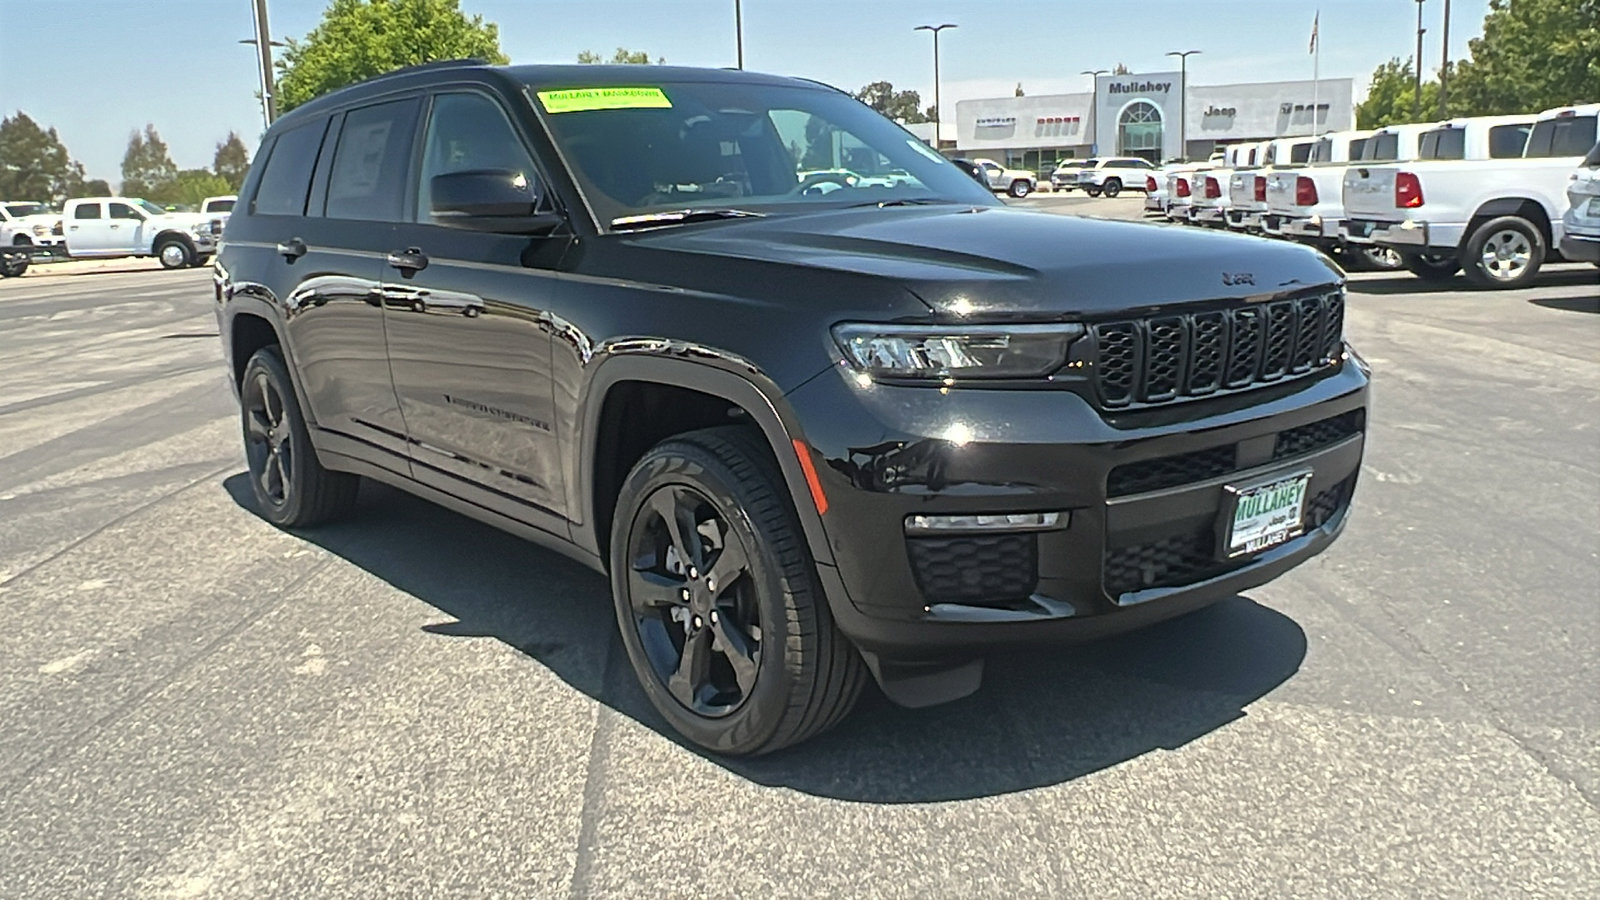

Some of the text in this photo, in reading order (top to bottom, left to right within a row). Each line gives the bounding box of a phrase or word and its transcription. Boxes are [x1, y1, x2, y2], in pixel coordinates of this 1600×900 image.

[1109, 81, 1171, 95] Mullahey
[1204, 105, 1237, 117] Jeep
[1236, 483, 1304, 521] MULLAHEY
